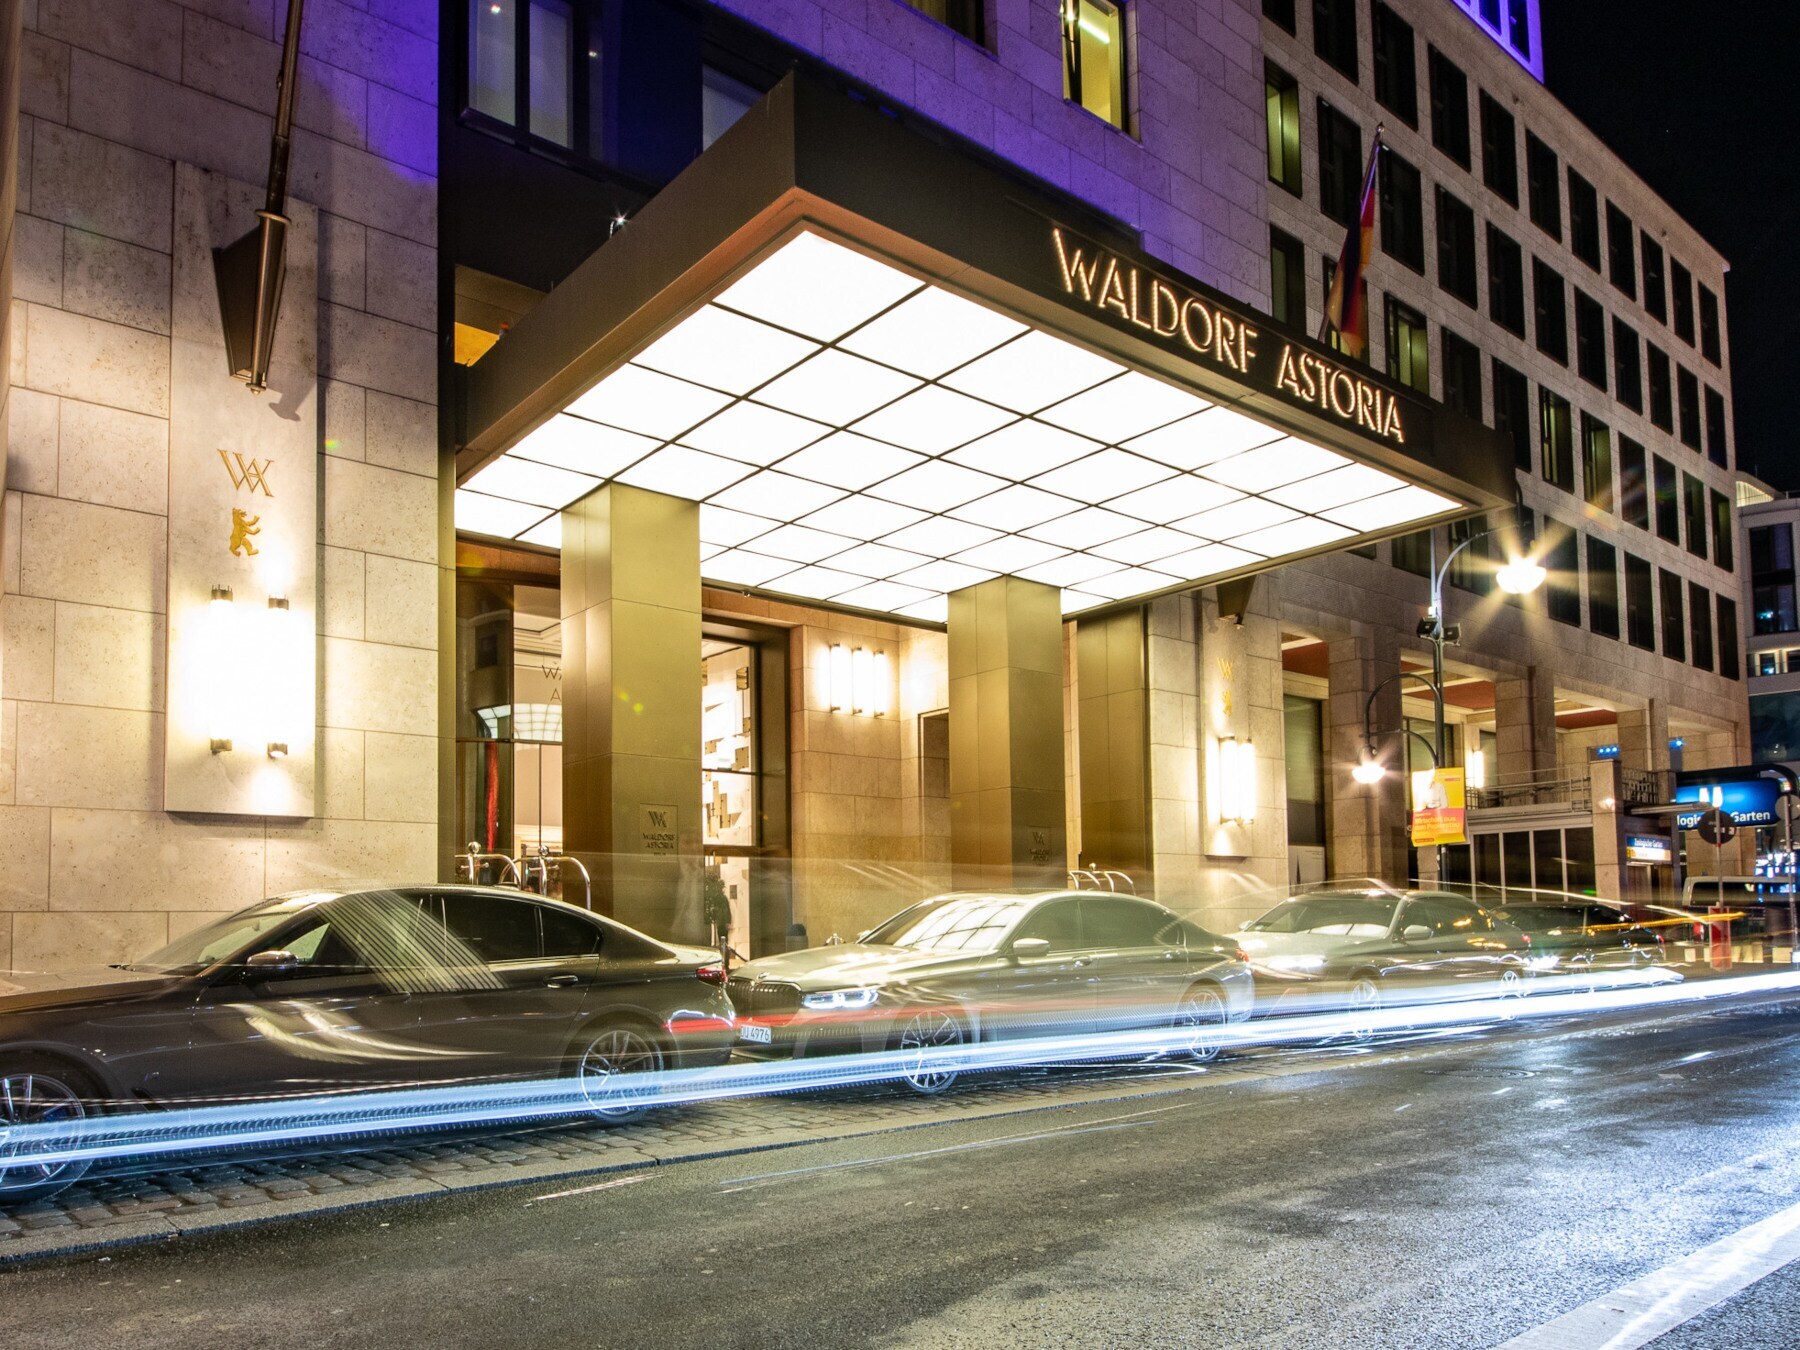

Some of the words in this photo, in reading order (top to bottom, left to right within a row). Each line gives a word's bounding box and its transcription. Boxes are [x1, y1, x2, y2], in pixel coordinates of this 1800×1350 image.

[1054, 228, 1257, 373] WALDORF
[1277, 345, 1404, 443] ASTORIA
[1730, 811, 1770, 822] Garten
[750, 1027, 769, 1041] 4976
